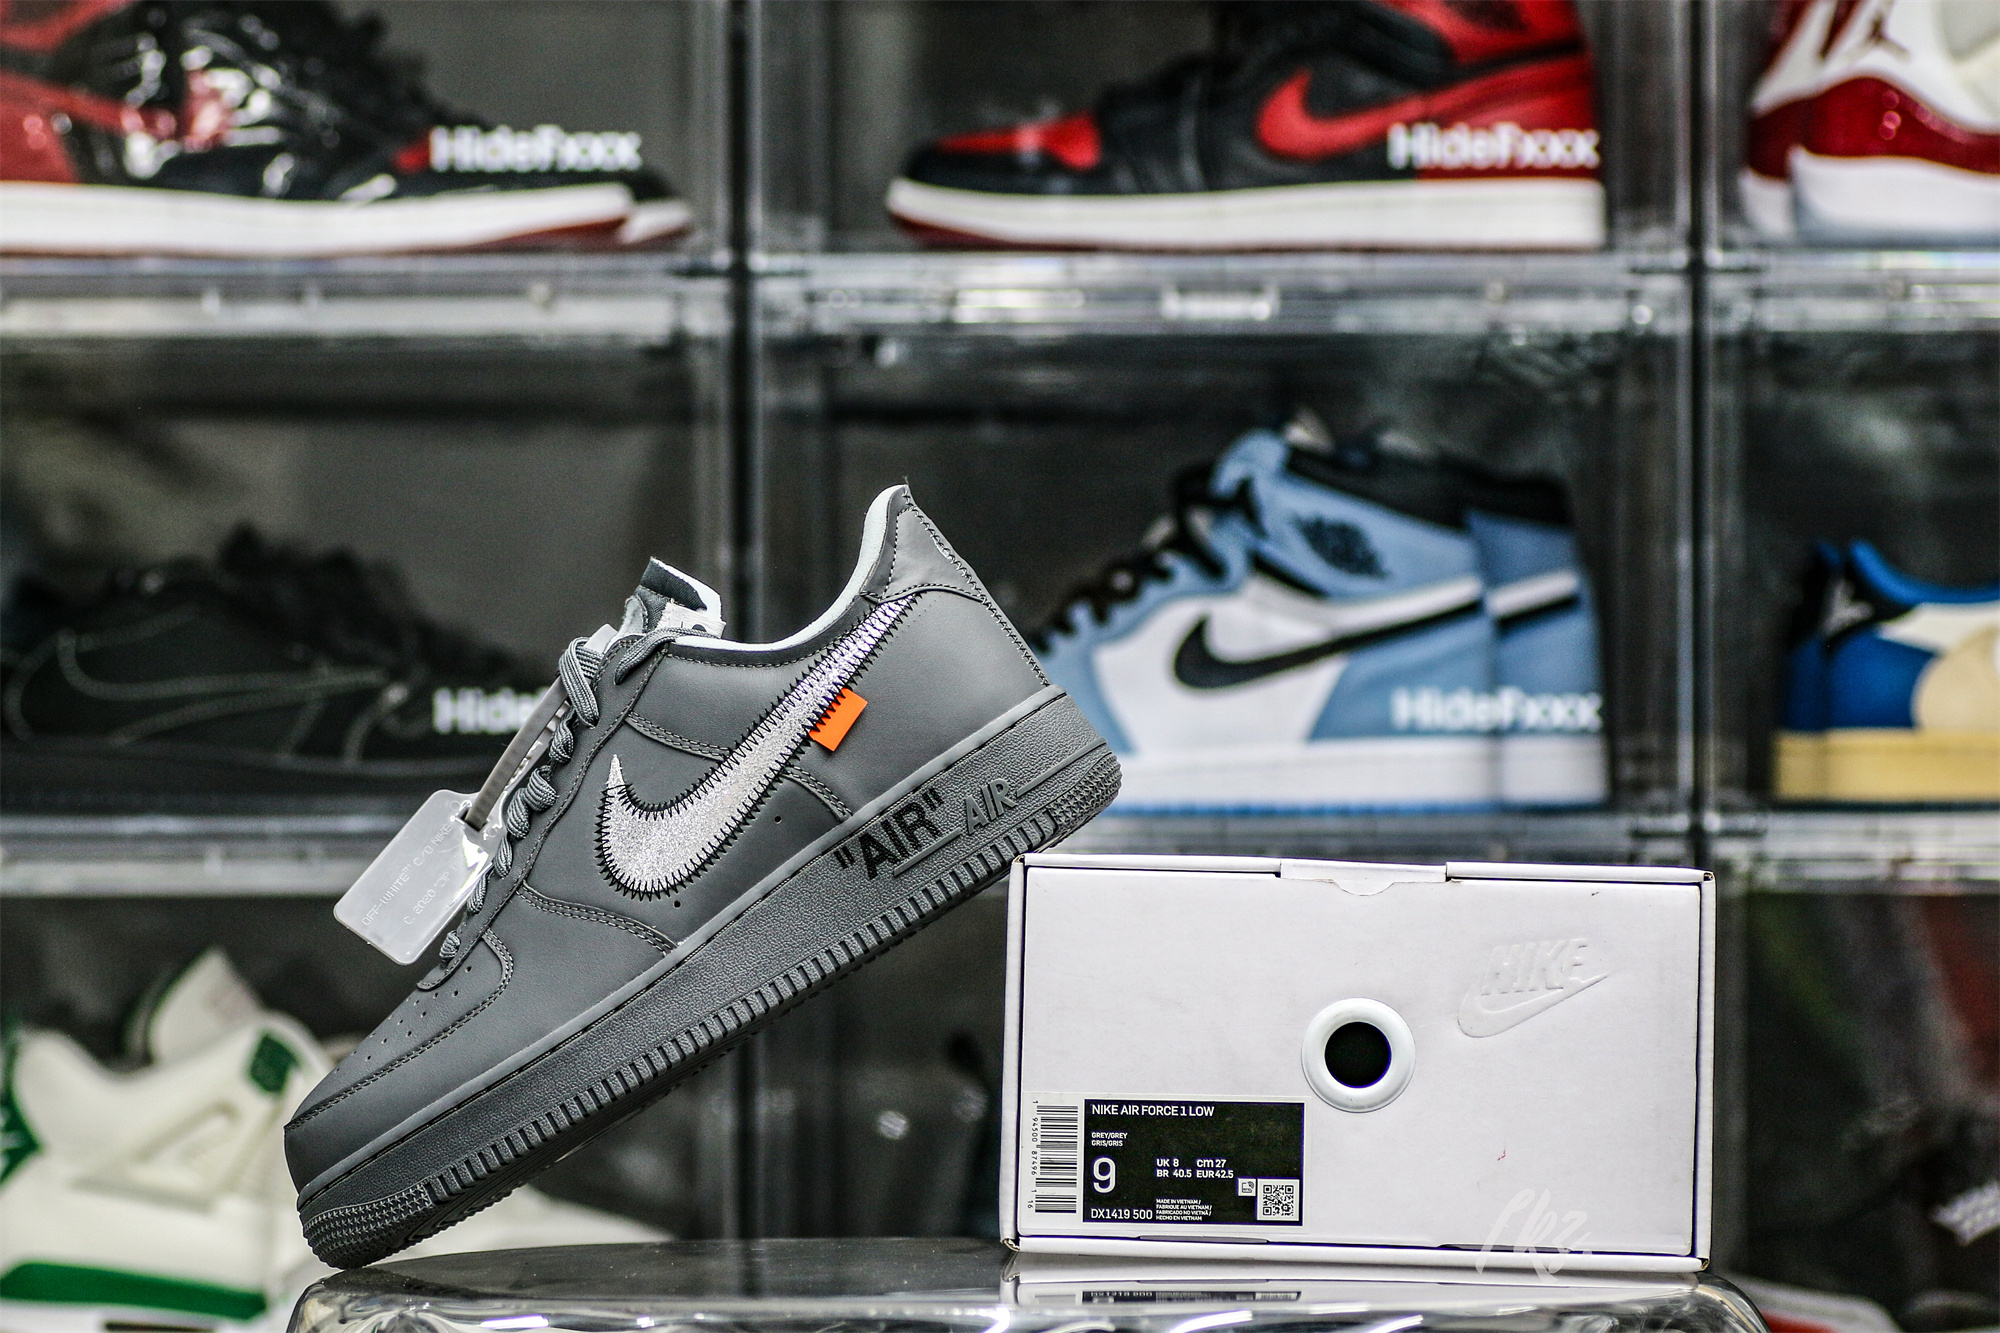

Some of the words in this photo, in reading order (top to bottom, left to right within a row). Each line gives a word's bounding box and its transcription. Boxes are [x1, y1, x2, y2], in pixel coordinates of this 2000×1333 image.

[964, 778, 1017, 835] AIR
[431, 824, 453, 847] NIKE
[833, 788, 944, 880] "AIR"
[413, 889, 436, 915] 2020
[1481, 938, 1588, 996] NIKE
[1091, 1104, 1119, 1115] NIKE
[1120, 1105, 1140, 1115] AIR
[1141, 1105, 1178, 1116] FORCE
[1180, 1106, 1187, 1116] 1
[1189, 1106, 1214, 1117] LOW
[1091, 1131, 1128, 1139] GREY/GREY
[1156, 1158, 1170, 1167] UK
[1172, 1158, 1179, 1167] 8
[1215, 1159, 1227, 1168] 27
[1093, 1157, 1116, 1194] 9
[1156, 1169, 1169, 1177] BR
[1173, 1169, 1192, 1178] 40.5
[1196, 1170, 1215, 1178] EUR
[1215, 1170, 1234, 1179] 42.5
[1027, 1200, 1034, 1209] 16
[1091, 1208, 1131, 1219] DX1419
[1132, 1209, 1153, 1220] 500
